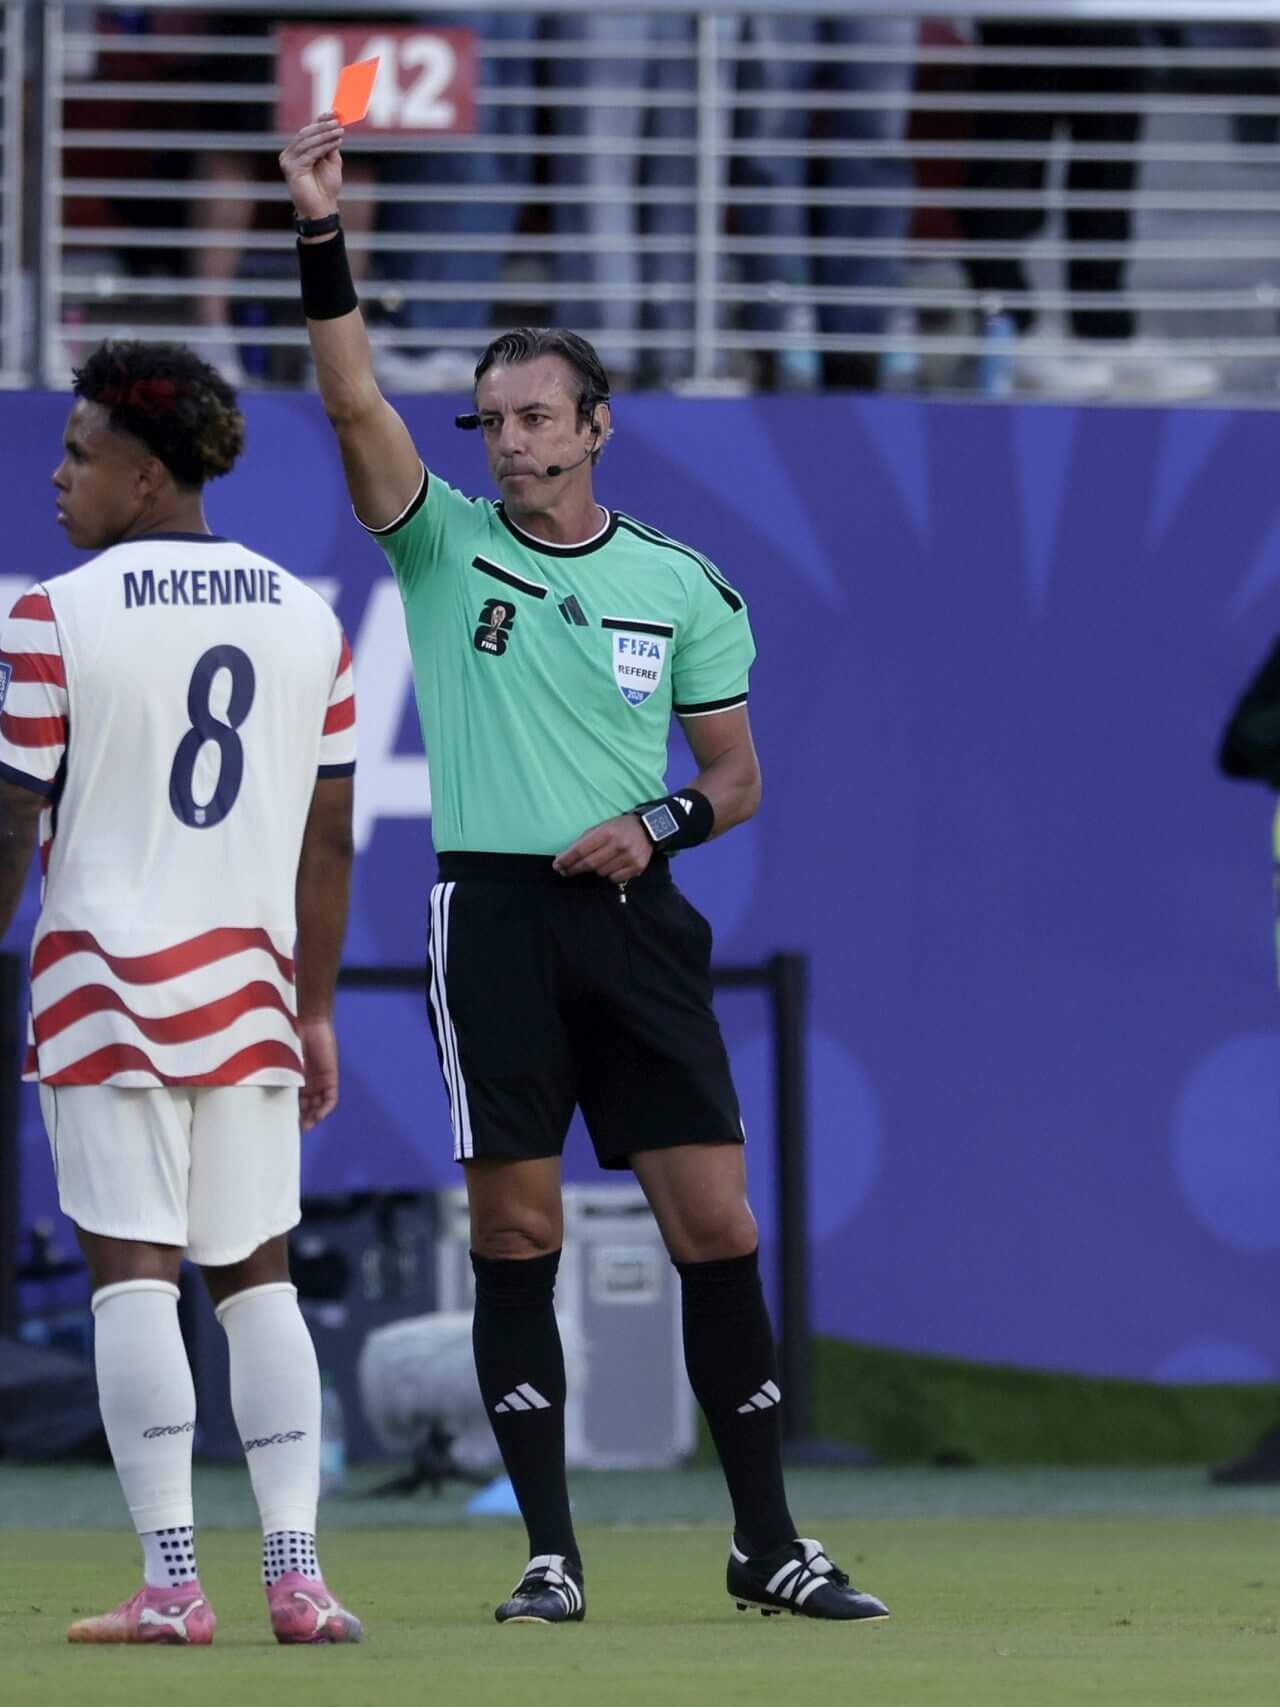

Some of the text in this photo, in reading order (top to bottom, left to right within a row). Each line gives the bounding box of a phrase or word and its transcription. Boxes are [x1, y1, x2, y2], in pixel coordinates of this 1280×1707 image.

[123, 568, 282, 609] McKENNIE
[480, 640, 498, 652] FIFA
[617, 637, 661, 660] FIFA
[618, 664, 659, 681] REFEREE
[168, 643, 257, 829] 8
